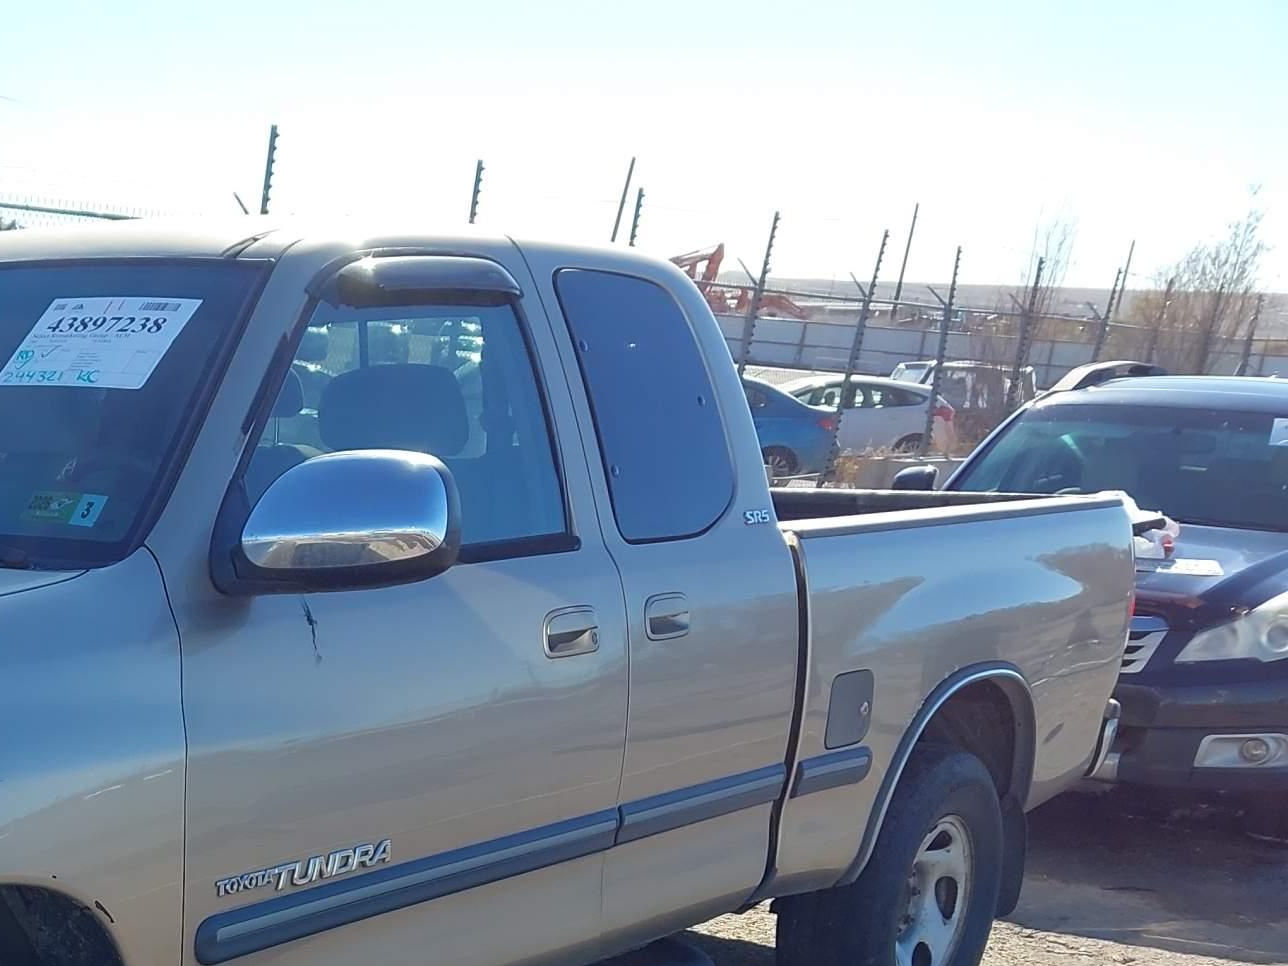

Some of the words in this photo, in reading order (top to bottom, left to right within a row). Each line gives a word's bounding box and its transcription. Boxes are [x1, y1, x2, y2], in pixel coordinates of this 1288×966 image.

[47, 316, 167, 333] 43897238
[80, 501, 96, 519] 3
[743, 509, 770, 525] SR5
[215, 868, 275, 897] TOYOTA
[271, 838, 393, 891] TUNDRA
